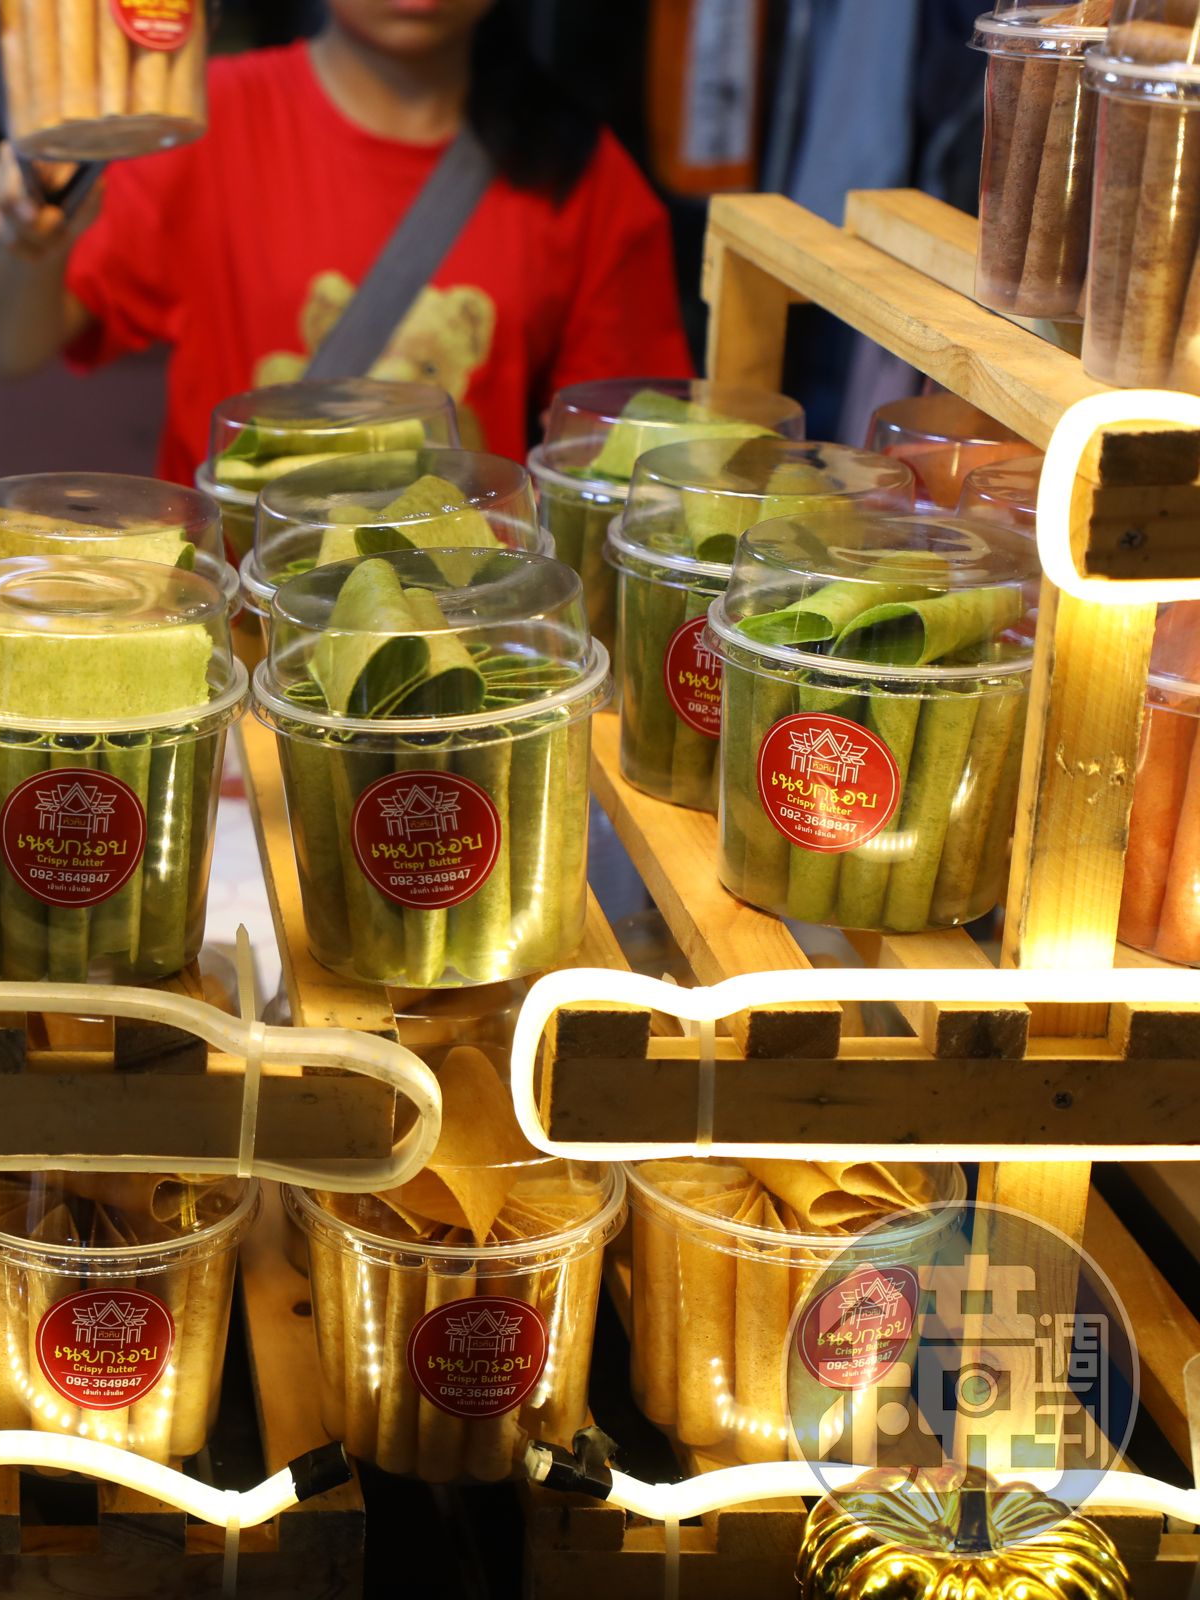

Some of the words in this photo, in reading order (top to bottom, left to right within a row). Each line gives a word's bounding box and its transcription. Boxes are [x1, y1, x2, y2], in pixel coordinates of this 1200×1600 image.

[695, 690, 721, 702] Crispy
[772, 772, 877, 808] เนยกรอบ
[787, 794, 815, 809] Crispy
[820, 803, 852, 816] Butter
[780, 807, 857, 833] 092-3649847
[17, 834, 127, 855] เนยกรอบ
[372, 833, 482, 858] เนยกรอบ
[37, 855, 68, 867] Crispy
[73, 858, 104, 866] Butter
[394, 861, 425, 871] Crispy
[429, 857, 462, 867] Butter
[30, 869, 110, 883] 092-3649847
[390, 869, 471, 885] 092-3649847
[818, 1317, 907, 1345] เนยกรอบ
[55, 1345, 158, 1364] เนยกรอบ
[835, 1347, 862, 1355] Crispy
[73, 1364, 102, 1375] Crispy
[428, 1355, 532, 1373] เนยกรอบ
[66, 1376, 142, 1388] 092-3649847
[447, 1374, 477, 1383] Crispy
[481, 1375, 511, 1383] Butter
[440, 1386, 516, 1397] 092-3649847
